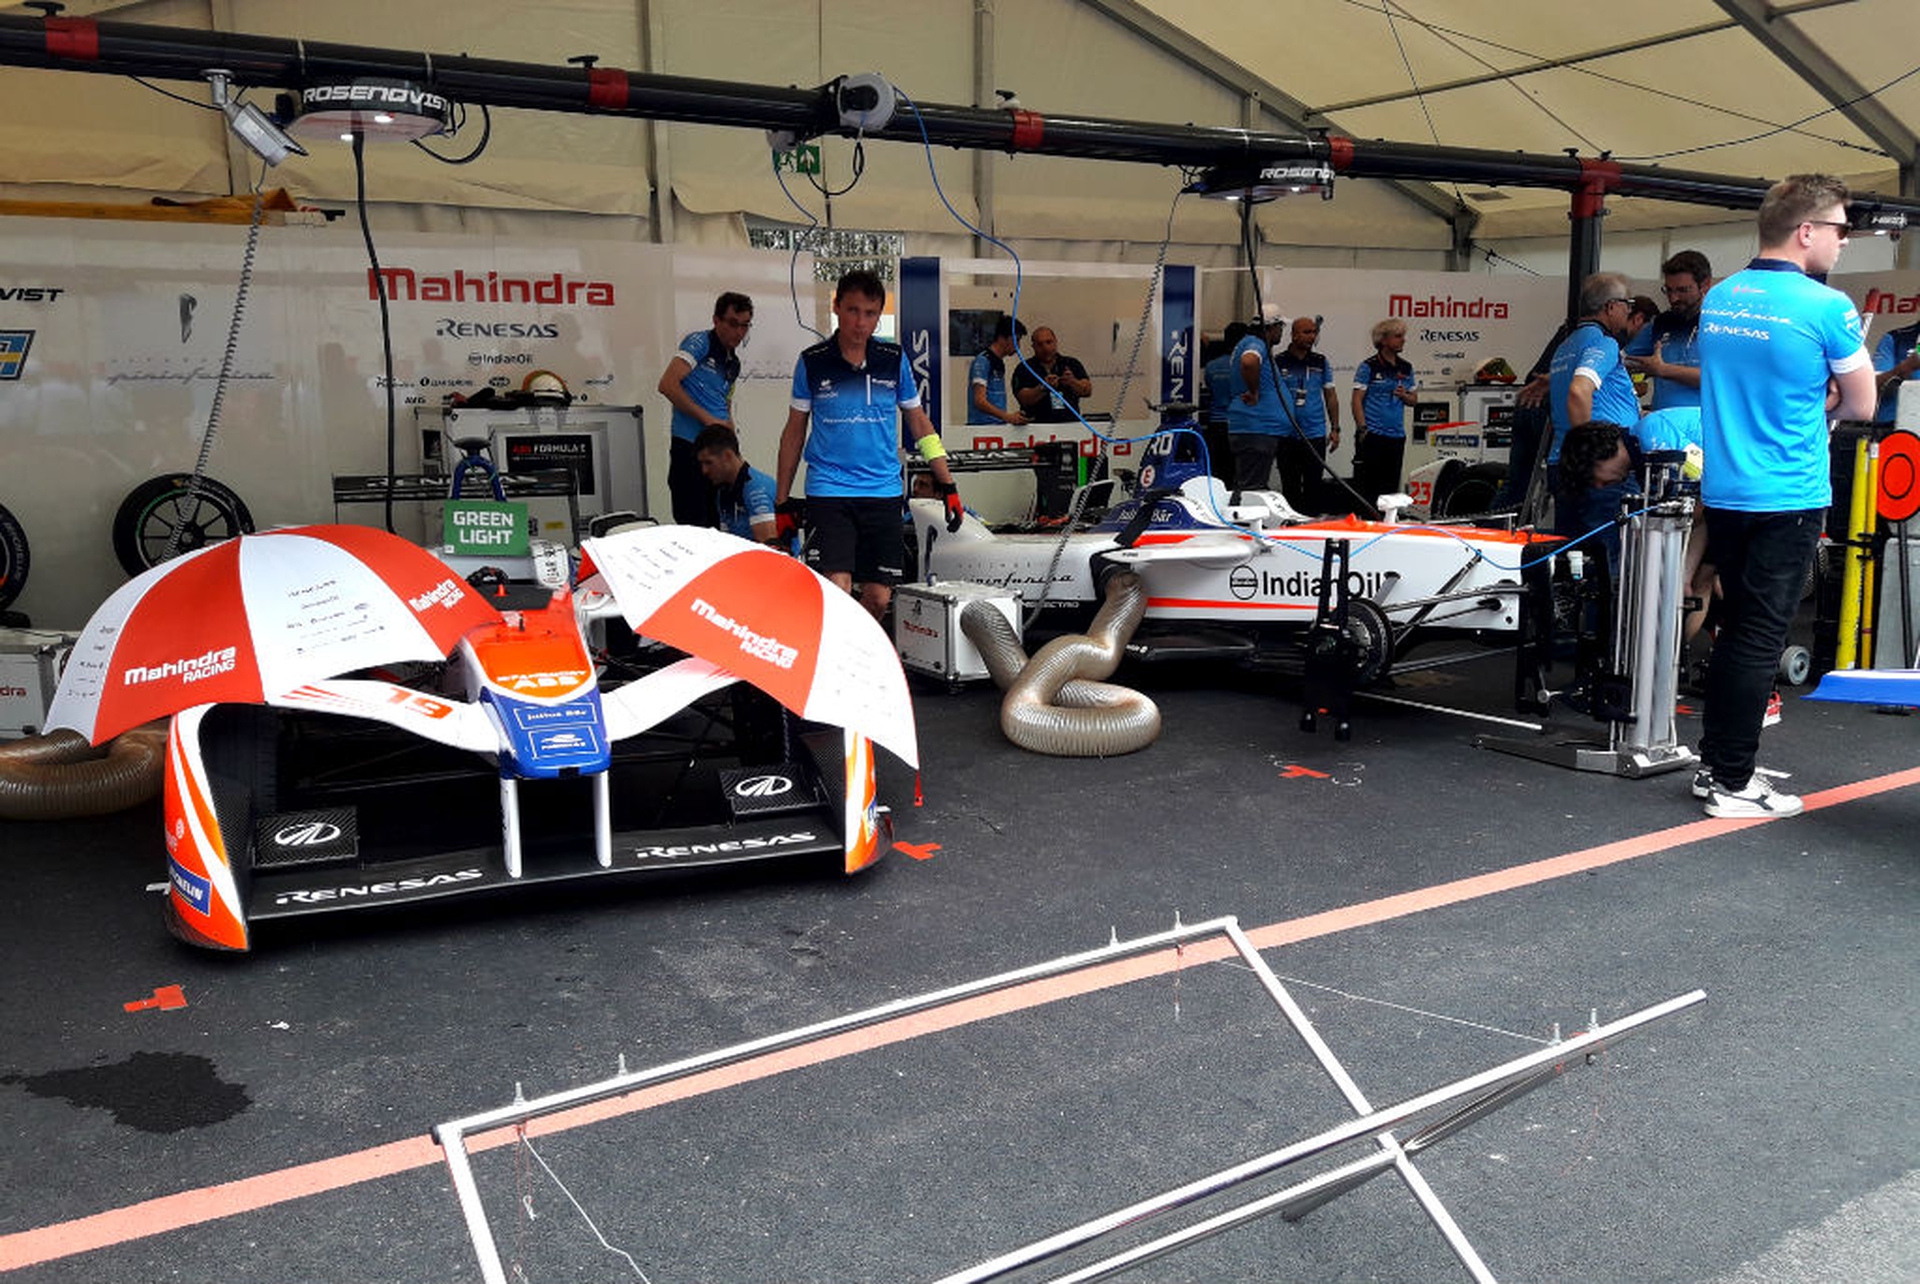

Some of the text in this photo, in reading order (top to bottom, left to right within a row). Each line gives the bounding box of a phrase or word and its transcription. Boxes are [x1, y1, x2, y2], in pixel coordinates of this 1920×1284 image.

[368, 268, 615, 306] Mahindra
[1389, 294, 1508, 319] Mahindra
[436, 319, 558, 339] RENESAS
[1420, 330, 1480, 342] RENESAS
[1703, 322, 1770, 341] RENESAS
[1409, 481, 1431, 505] 23
[453, 511, 513, 527] GREEN
[459, 529, 513, 545] LIGHT
[691, 598, 799, 658] Mahindra
[124, 646, 237, 685] Mahindra
[183, 659, 236, 684] RACING
[512, 676, 580, 690] ABB
[637, 832, 816, 859] RENESAS
[276, 868, 484, 905] RENESAS
